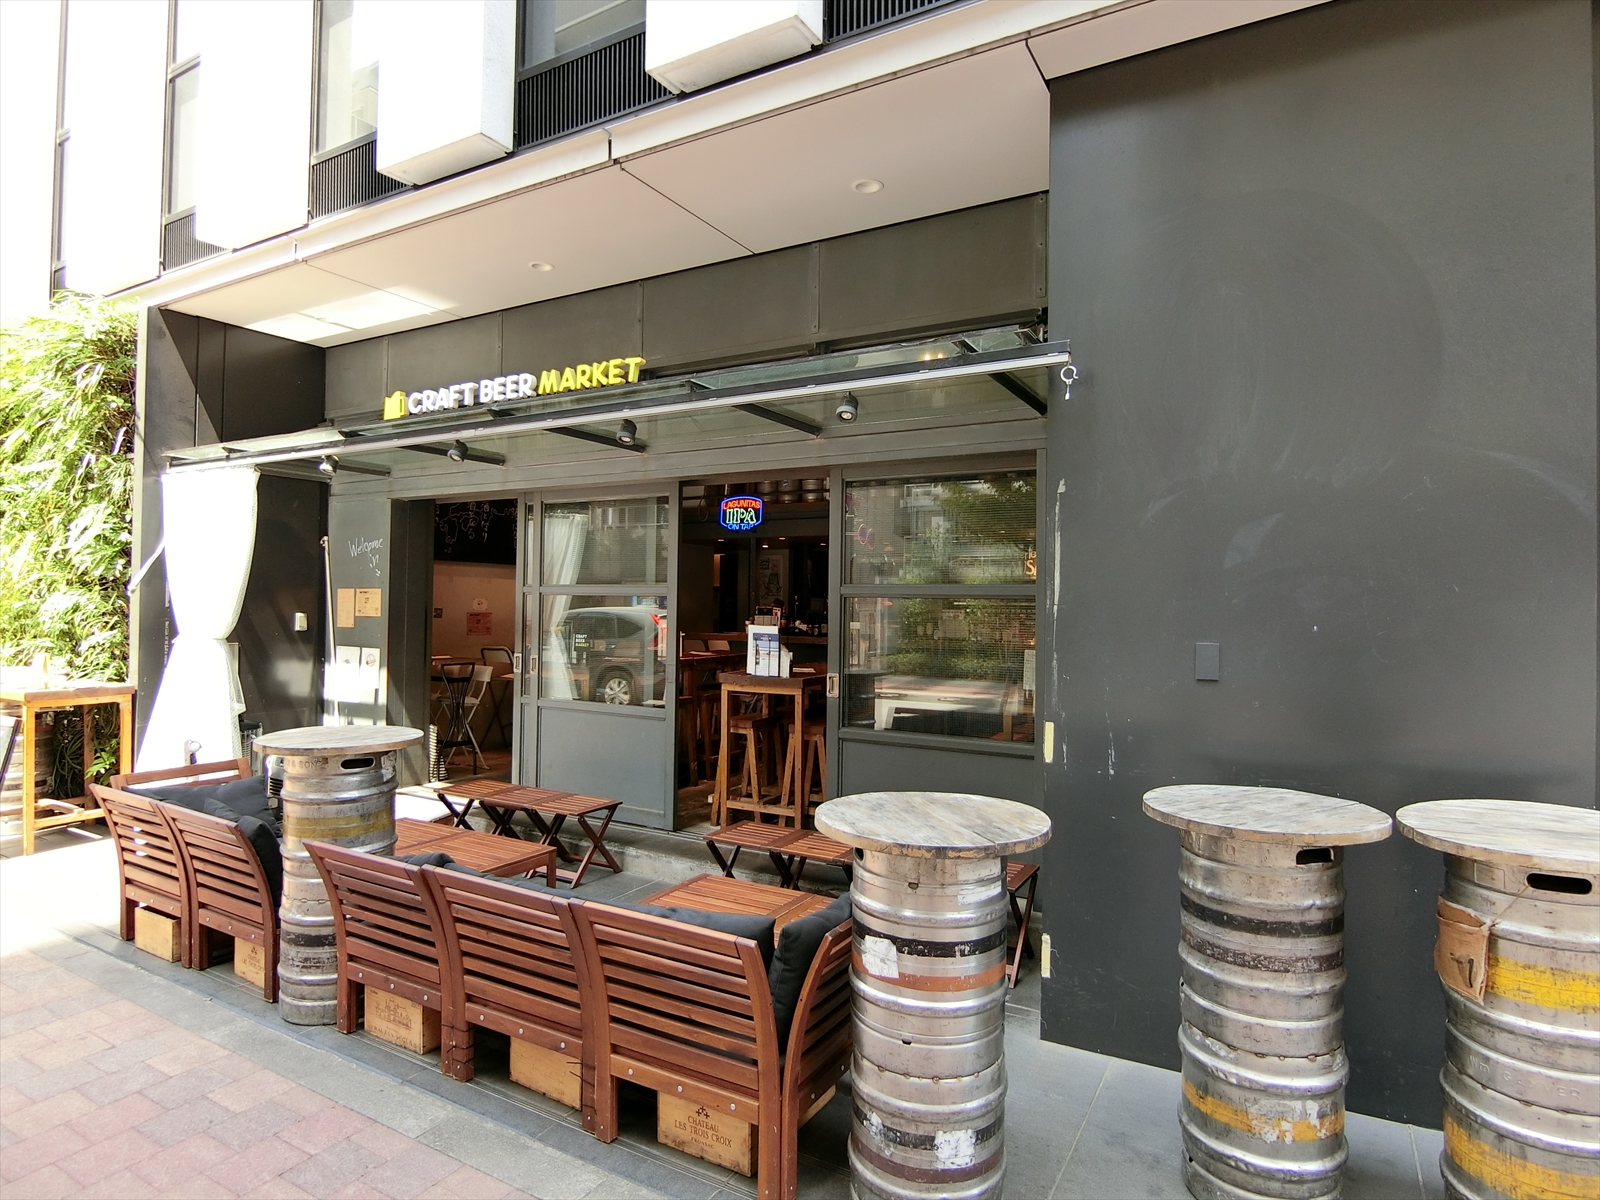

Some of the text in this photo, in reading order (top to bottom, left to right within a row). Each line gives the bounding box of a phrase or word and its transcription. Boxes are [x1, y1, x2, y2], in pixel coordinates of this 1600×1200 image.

[408, 356, 646, 415] CRAFT BEER MARKET
[723, 499, 761, 510] LAGUNITAS
[726, 508, 756, 524] IPA
[347, 537, 384, 557] Welcome
[674, 1119, 732, 1148] LES TROIS CROIX
[687, 1115, 719, 1133] CHATEAU
